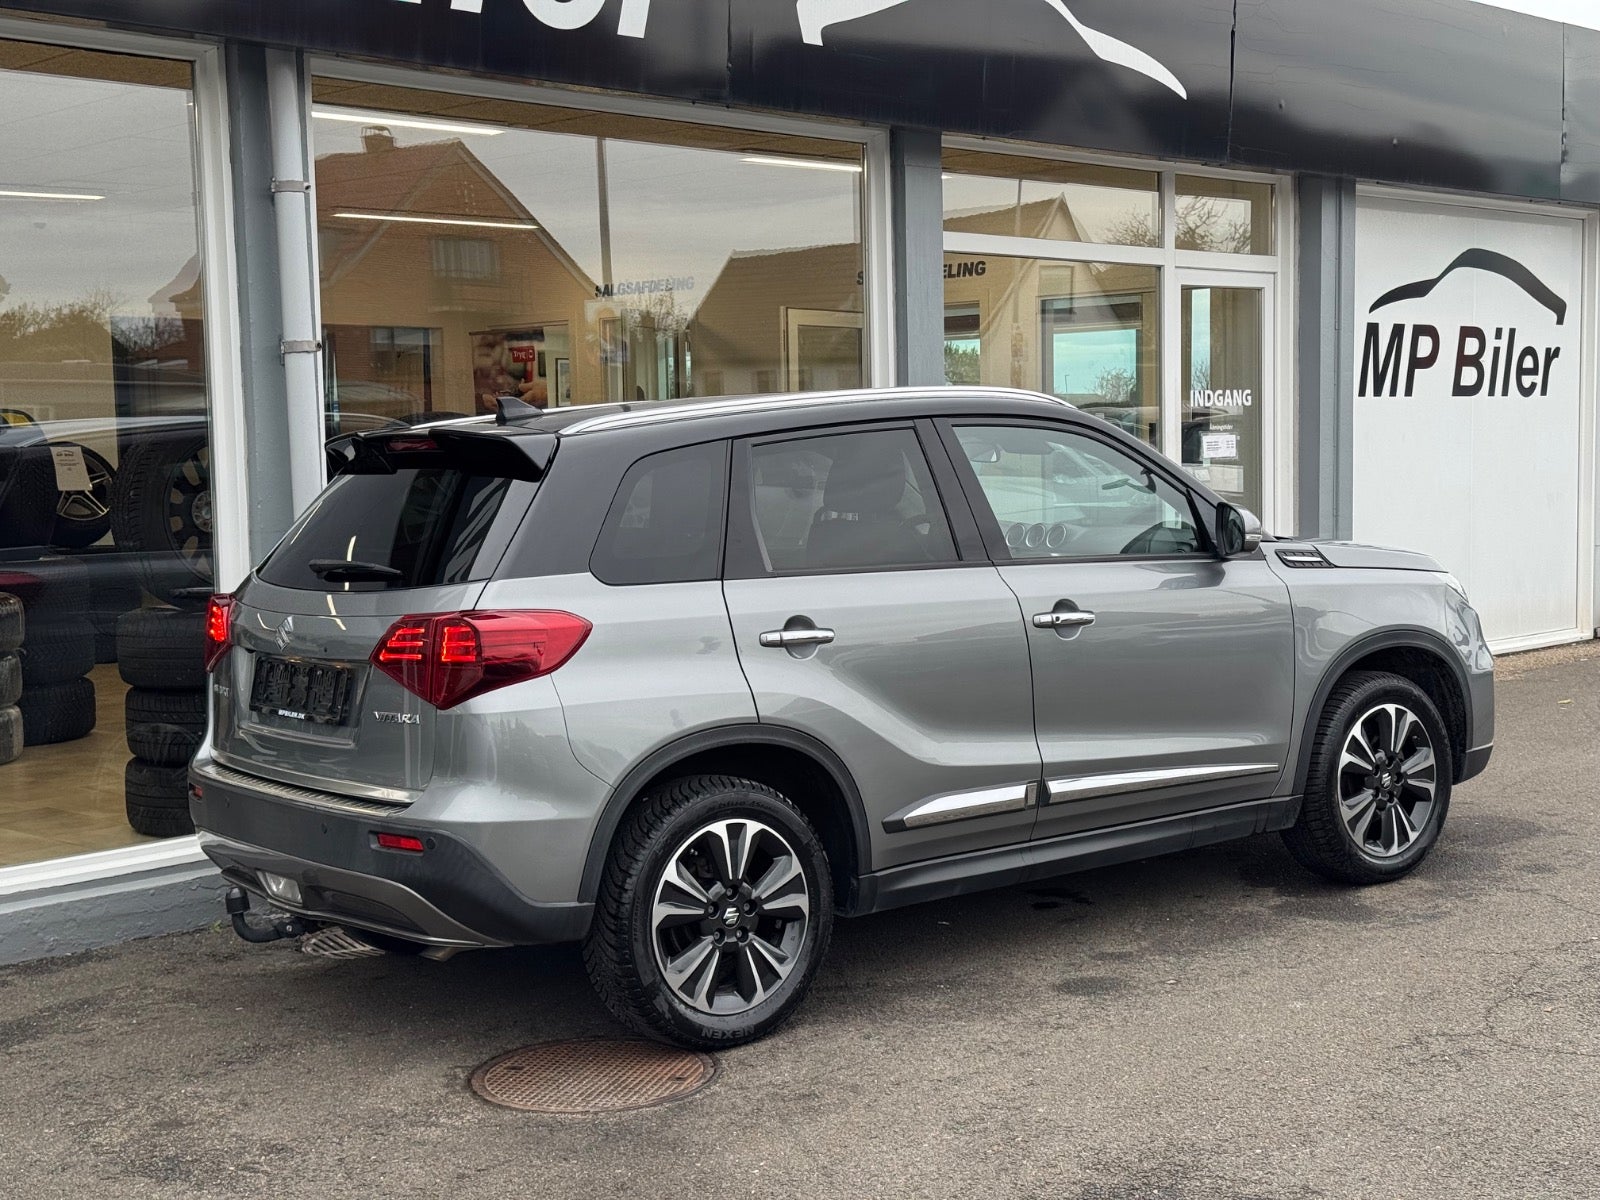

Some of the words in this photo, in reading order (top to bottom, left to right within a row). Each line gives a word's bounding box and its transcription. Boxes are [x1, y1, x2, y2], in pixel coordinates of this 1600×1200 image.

[595, 276, 695, 298] SALGSAFDELING
[1358, 322, 1440, 397] MP
[1452, 325, 1561, 398] Biler
[1190, 389, 1252, 407] INDGANG
[373, 711, 421, 725] VITARA
[701, 1025, 755, 1040] NEXEN
